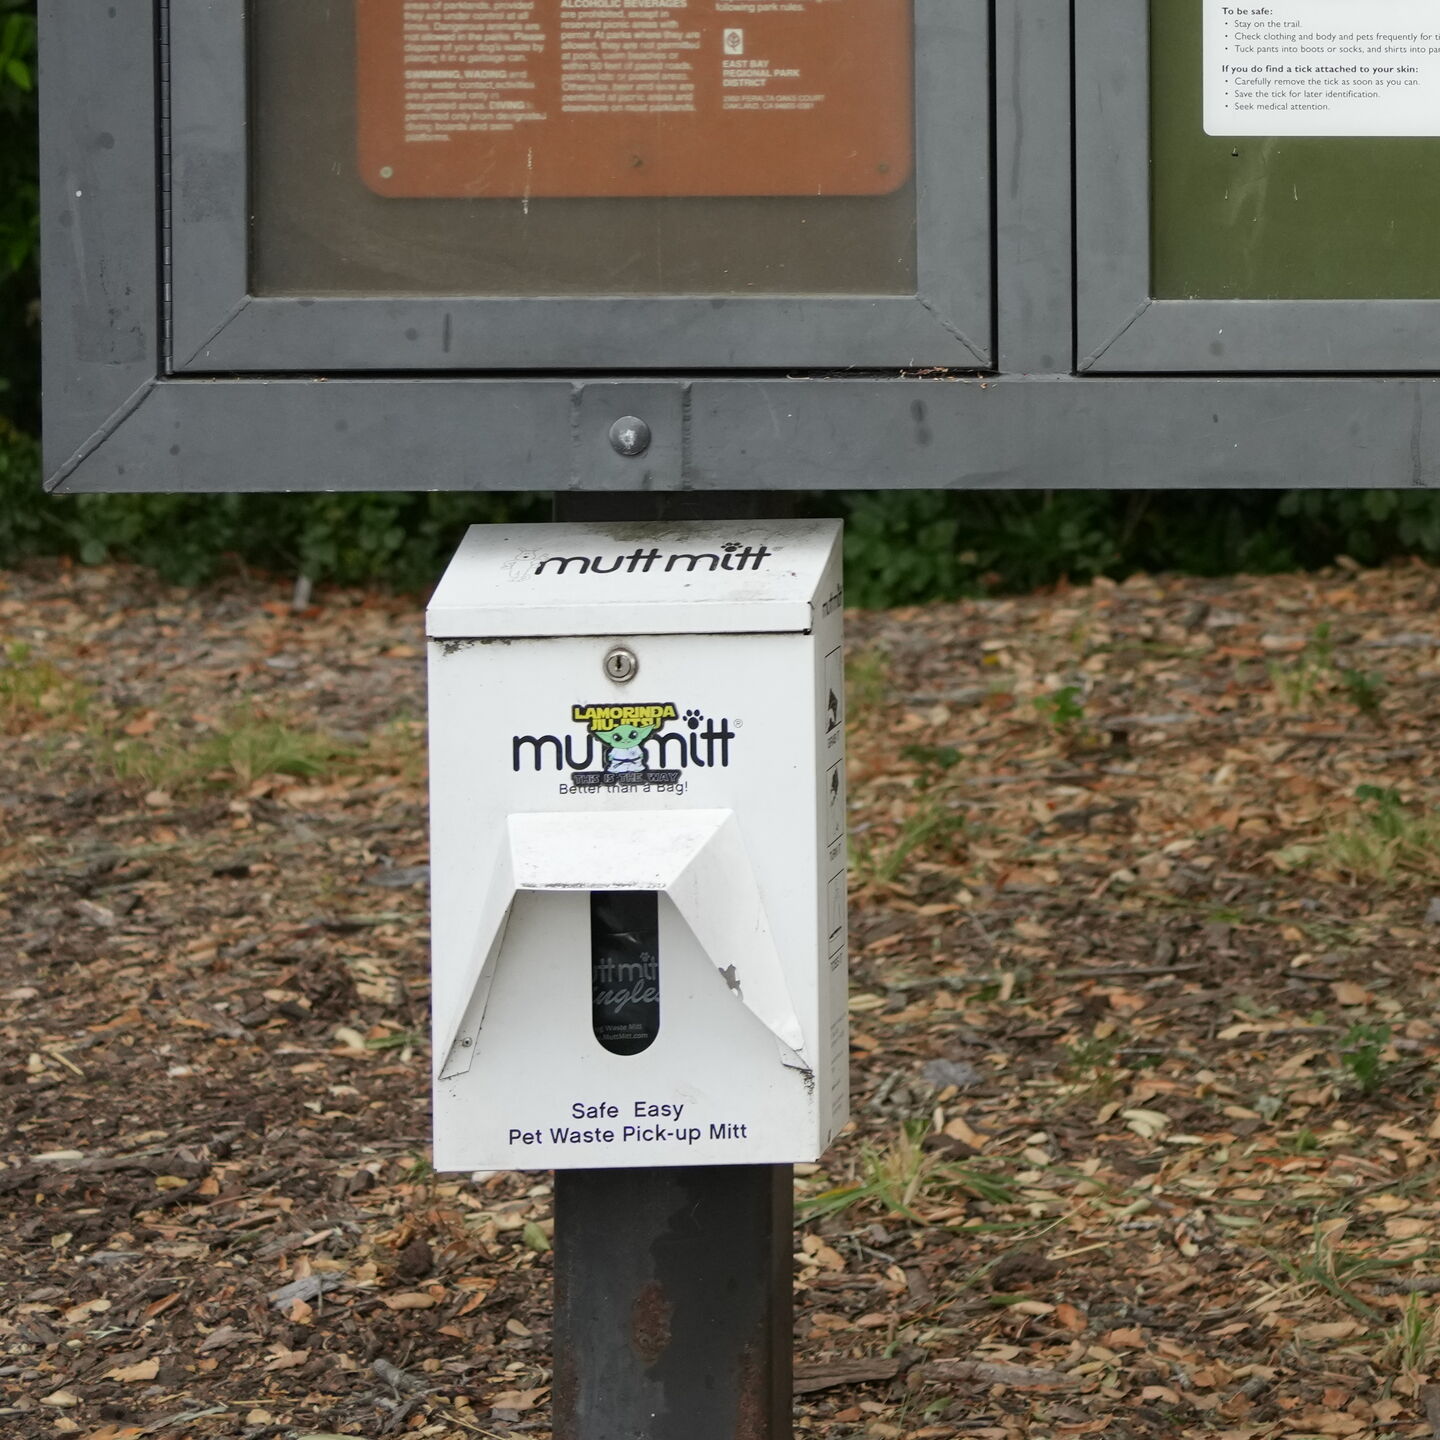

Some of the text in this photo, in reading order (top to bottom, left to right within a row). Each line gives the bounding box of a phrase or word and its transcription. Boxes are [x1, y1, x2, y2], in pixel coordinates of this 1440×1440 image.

[575, 705, 676, 719] LAMORINDA
[574, 773, 679, 784] THIS IS THE WAY
[657, 781, 688, 795] Bag!
[572, 1101, 684, 1122] Safe Easy
[509, 1123, 747, 1146] Pet Waste Pick-up Mitt
